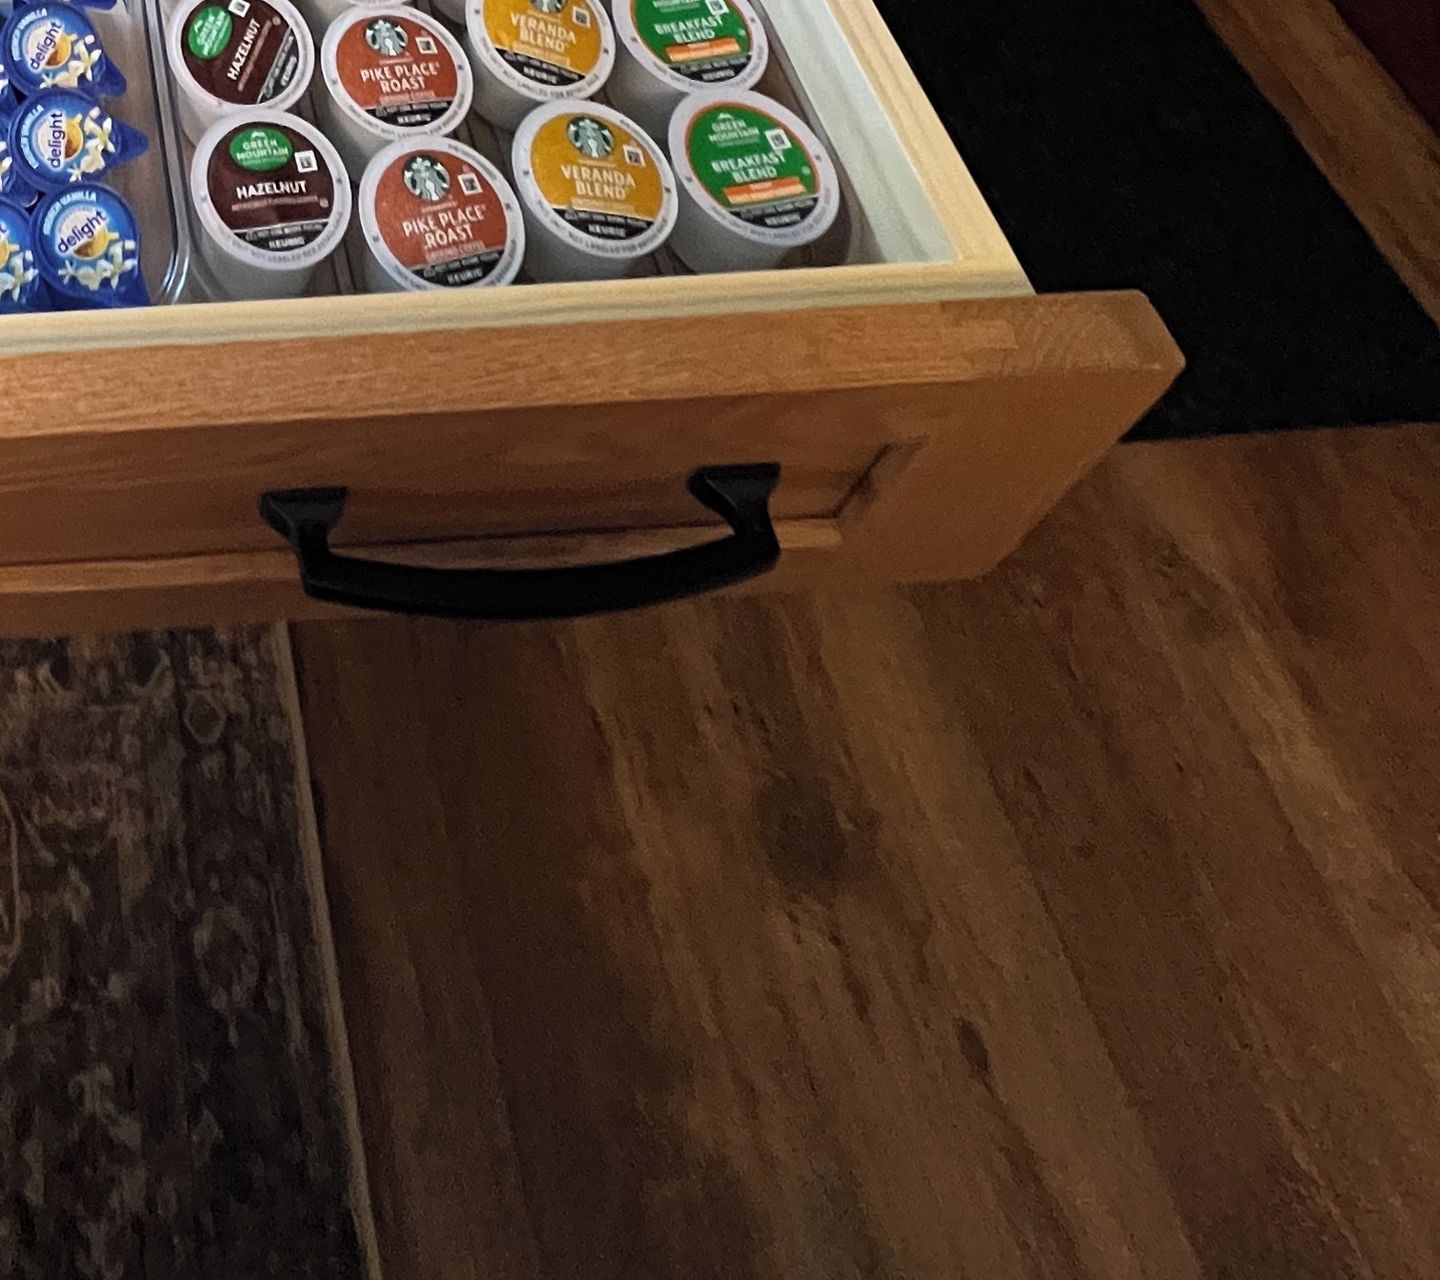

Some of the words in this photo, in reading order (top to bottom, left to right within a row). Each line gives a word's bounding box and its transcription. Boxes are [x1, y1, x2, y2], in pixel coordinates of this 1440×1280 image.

[510, 12, 577, 43] VERANDA
[654, 15, 723, 35] BREAKFAST
[673, 29, 715, 43] BLEND
[30, 21, 62, 69] delight
[226, 18, 260, 80] HAZELNUT
[519, 25, 566, 51] BLEND
[360, 65, 392, 82] PIKE
[395, 62, 438, 79] PLACE
[381, 77, 425, 94] ROAST
[49, 112, 66, 168] delight
[242, 139, 278, 151] GREEN
[236, 147, 289, 161] MOUNTAIN
[711, 151, 786, 173] BREAKFAST
[560, 164, 636, 187] VERANDA
[732, 166, 778, 184] BLEND
[59, 191, 97, 206] VANILLA
[236, 180, 308, 199] HAZELNUT
[576, 178, 626, 200] BLEND
[402, 214, 436, 237] PIKE
[438, 204, 484, 226] PLACE
[58, 210, 107, 254] delight
[268, 236, 306, 249] KEURIG
[424, 224, 474, 249] ROAST
